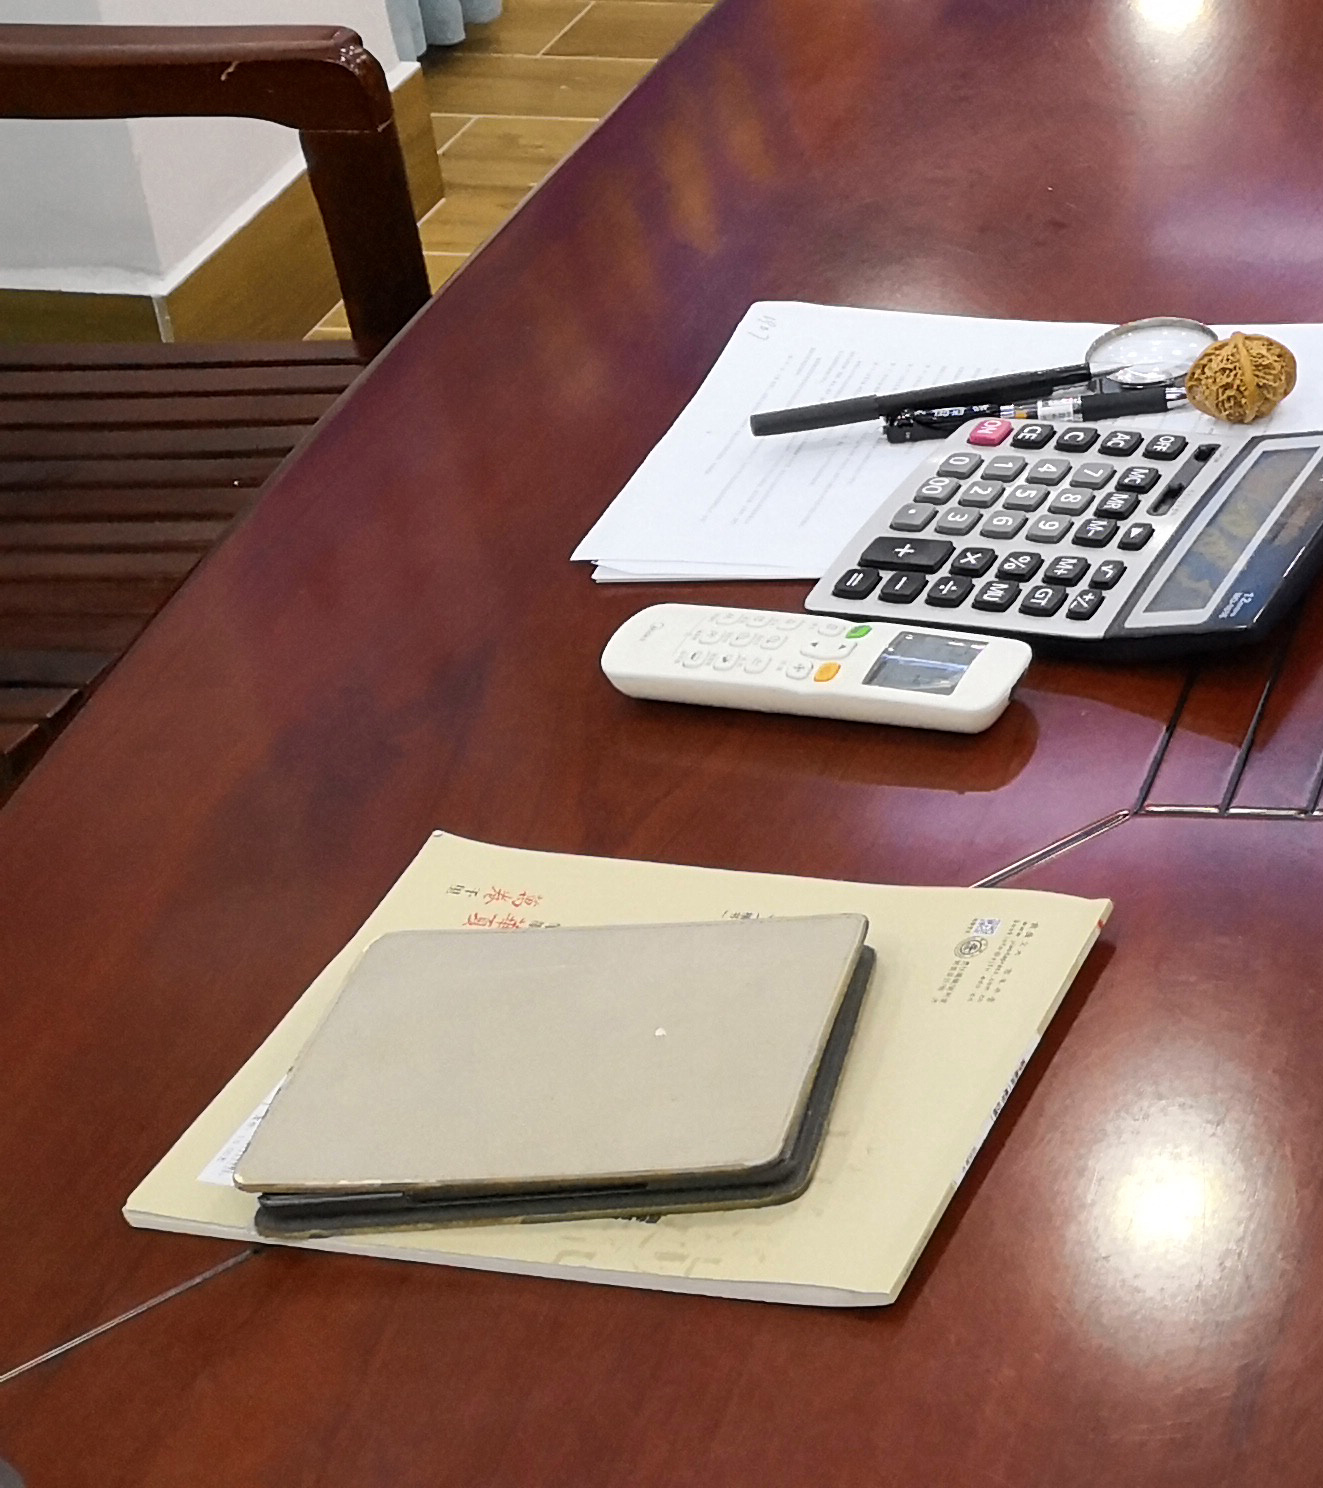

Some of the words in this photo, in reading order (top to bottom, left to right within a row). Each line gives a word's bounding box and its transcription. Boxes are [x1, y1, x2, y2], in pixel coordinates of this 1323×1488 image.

[978, 419, 1002, 434] ON
[1019, 426, 1042, 441] CE
[1064, 431, 1085, 442] C
[1104, 432, 1132, 449] AC
[1153, 435, 1176, 453] OFF
[949, 456, 970, 465] 0
[993, 461, 1013, 469] 1
[1037, 463, 1057, 473] 4
[1083, 467, 1104, 478] 7
[1127, 468, 1149, 486] MC
[921, 477, 949, 495] 00
[970, 485, 993, 496] 2
[1015, 489, 1036, 499] 5
[1060, 493, 1081, 503] 8
[1104, 492, 1131, 510] MR
[947, 512, 968, 522] 3
[992, 516, 1013, 526] 6
[1038, 520, 1059, 530] 9
[982, 583, 1010, 602] MU
[1030, 588, 1053, 606] GT
